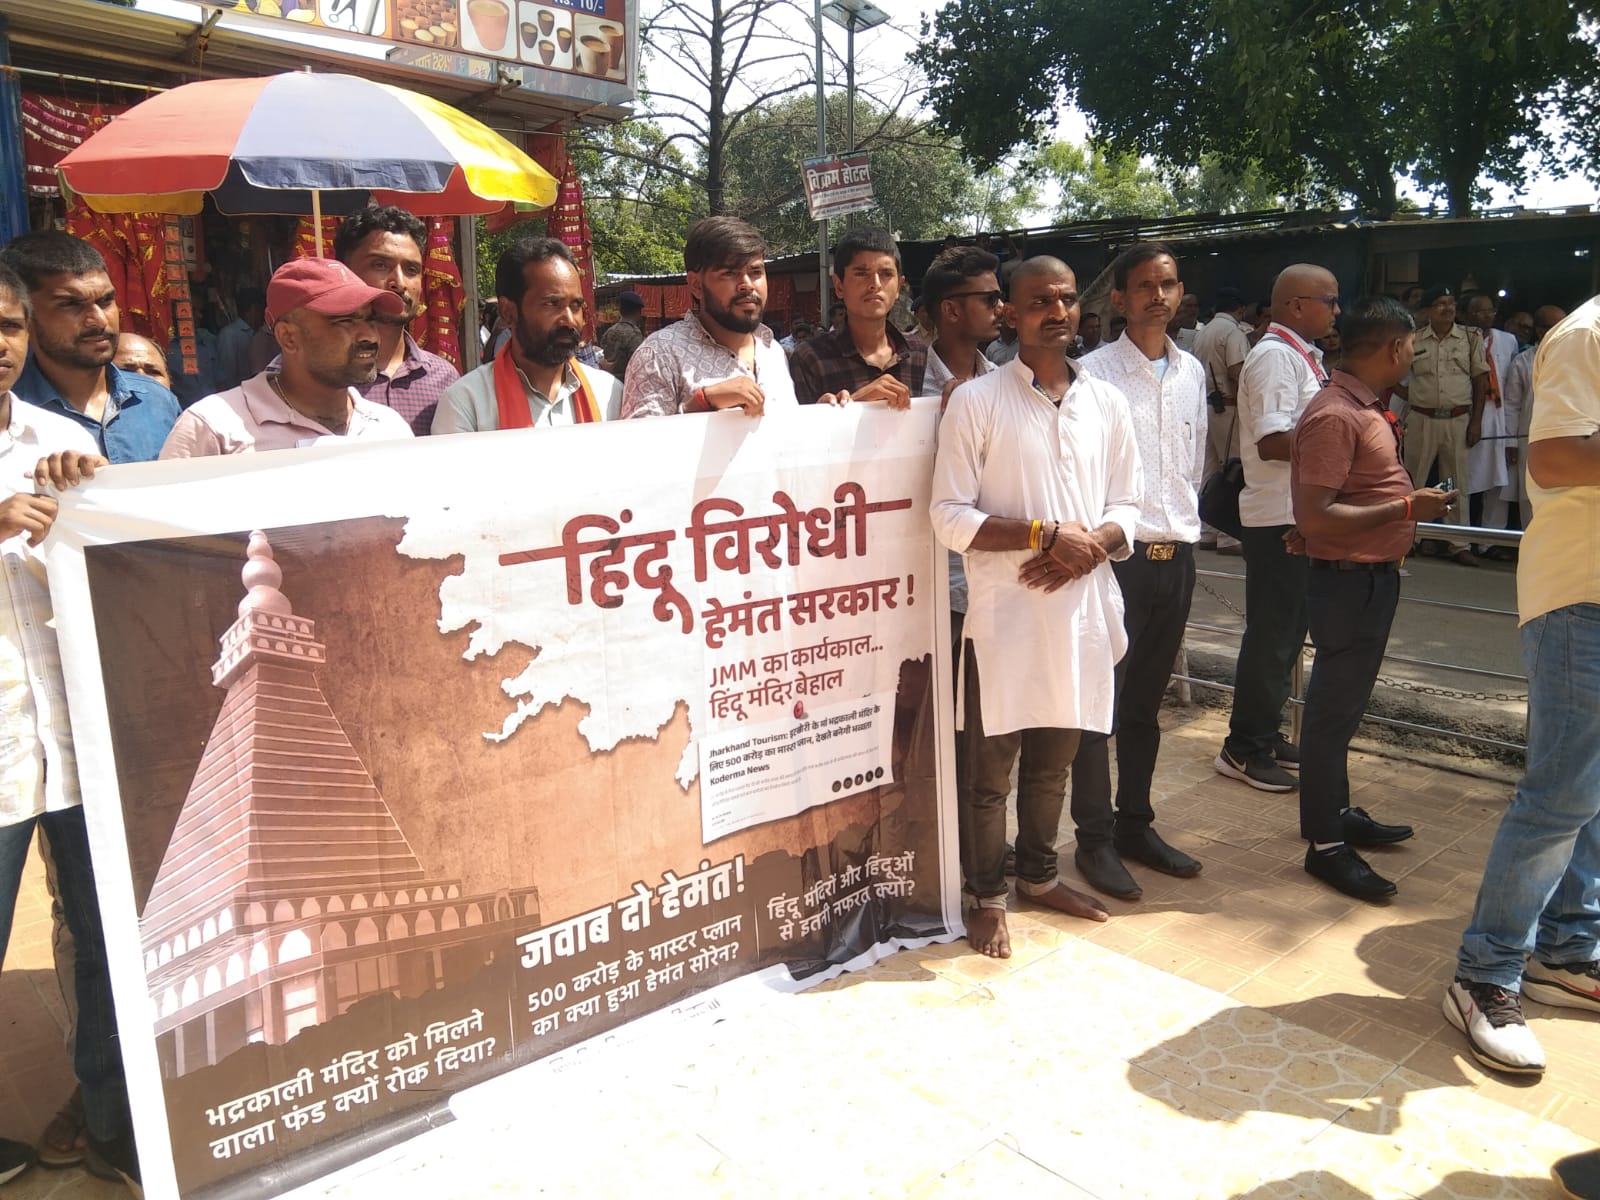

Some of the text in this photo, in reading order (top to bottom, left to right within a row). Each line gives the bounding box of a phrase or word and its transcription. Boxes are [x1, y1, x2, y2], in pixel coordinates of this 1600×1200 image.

[806, 163, 871, 191] विक्रम होटल
[499, 482, 912, 634] हिंदू विरोधी
[701, 591, 783, 649] हेमंत
[709, 658, 757, 688] JMM
[761, 652, 788, 675] का
[709, 669, 844, 721] हिंदू मंदिर बेहाल
[709, 739, 751, 758] Jharkhand
[752, 733, 789, 746] Tourism:
[709, 760, 724, 772] लिए
[725, 755, 742, 767] 500
[764, 747, 776, 756] का
[710, 763, 770, 786] Koderma News
[516, 856, 745, 970] जवाब दो हेमंत!
[767, 850, 915, 920] हिंदू मंदिरों और हिंदूओं
[779, 876, 916, 941] से इतनी नफरत क्यों?
[528, 914, 742, 1013] 500 करोड़ के मास्टर प्लान
[532, 942, 740, 1037] का क्या हुआ हेमंत सोरेन?
[205, 1008, 485, 1128] भद्रकाली मंदिर को मिलने
[209, 1037, 497, 1160] वाला फंड क्यों रोक दिया?
